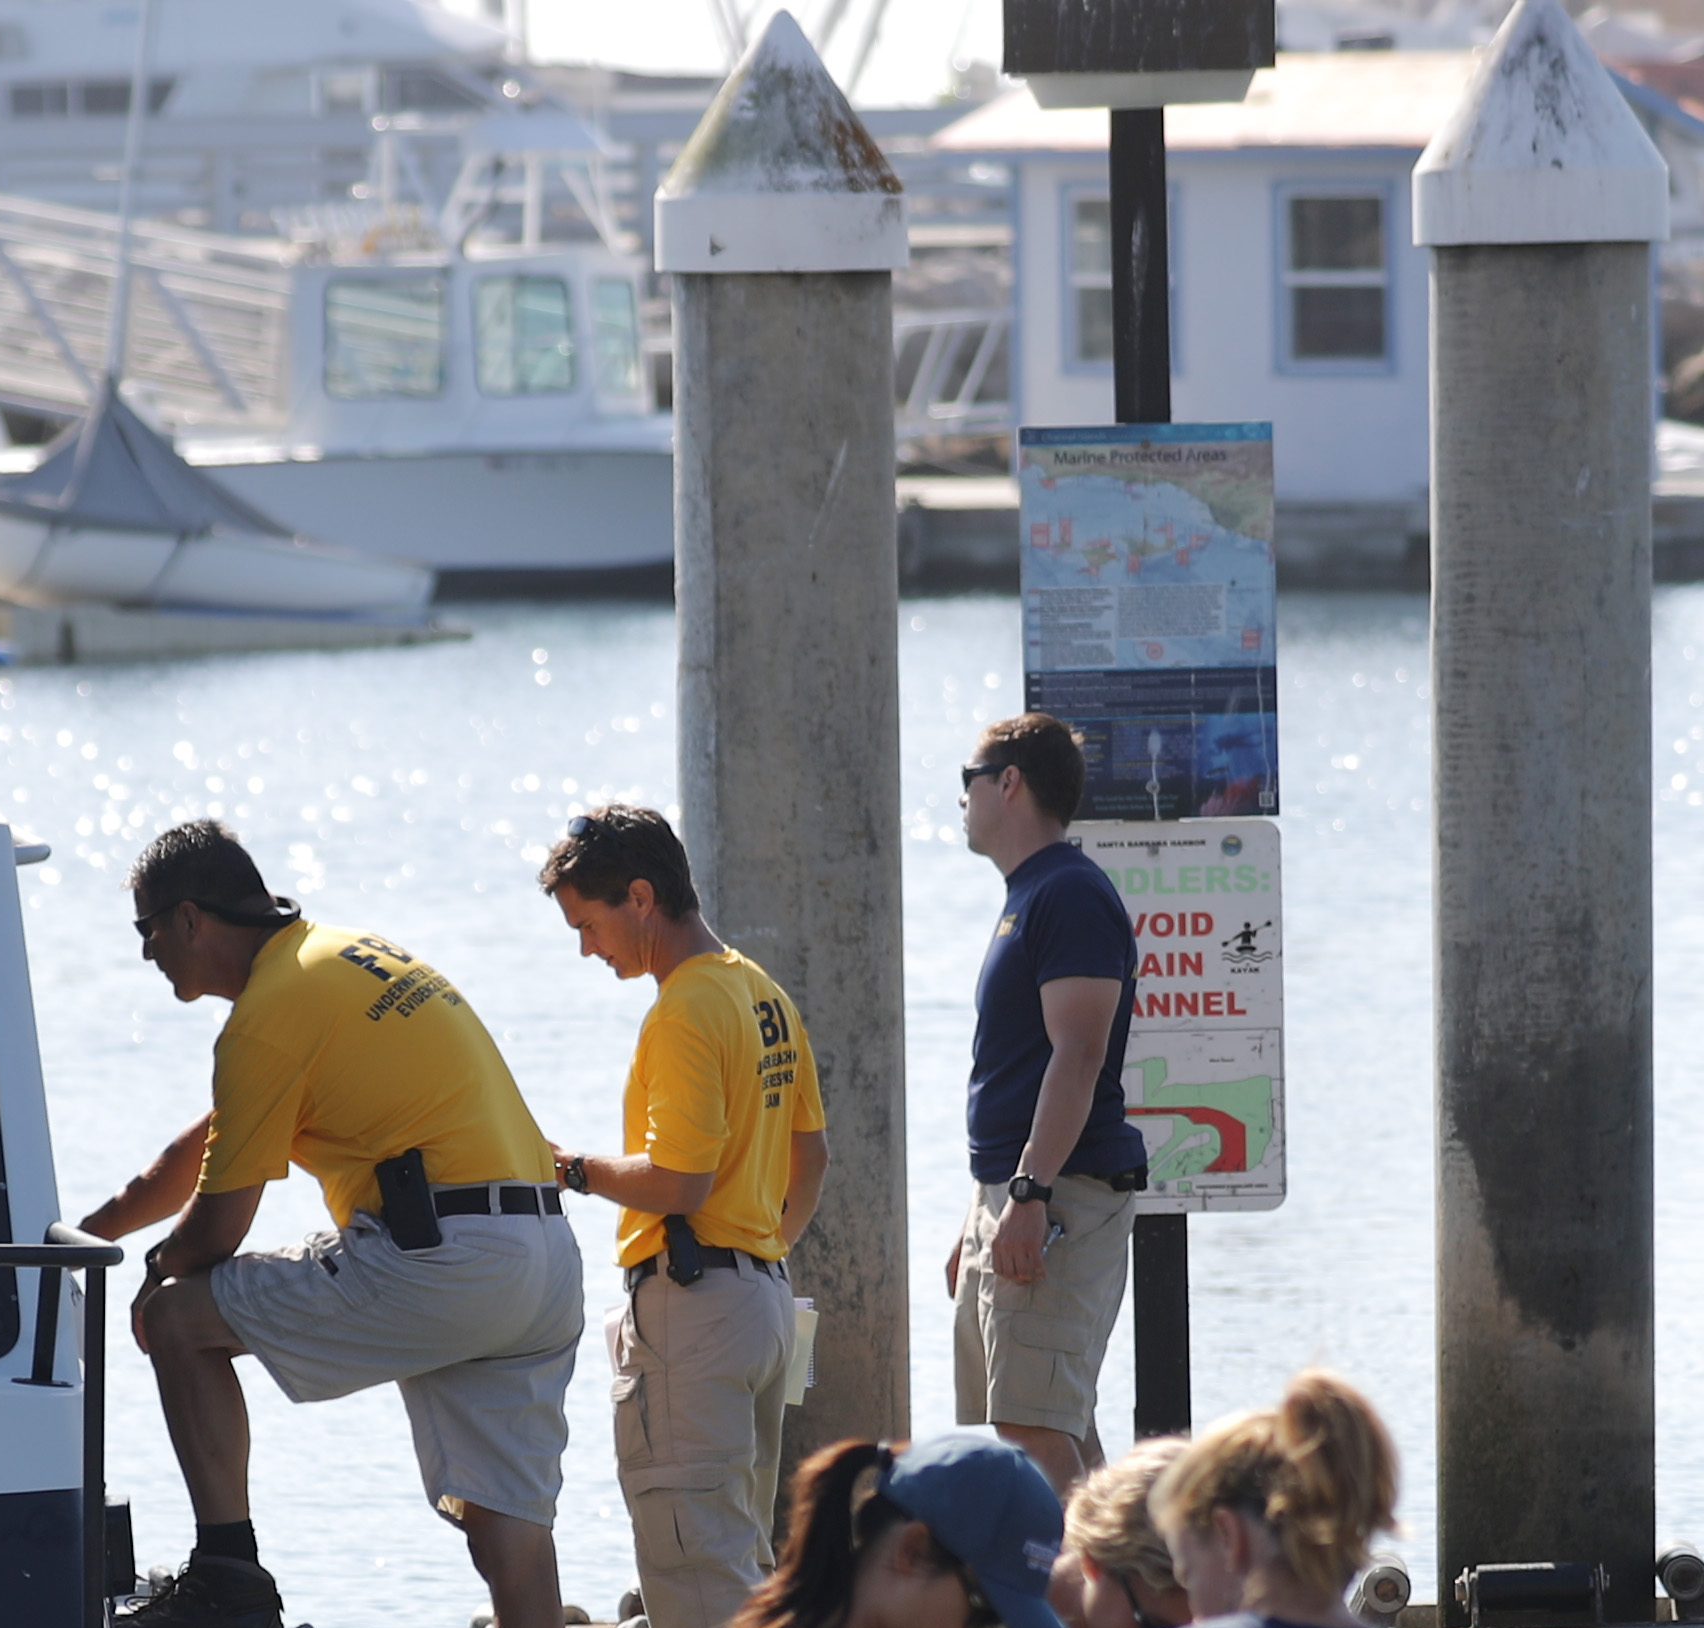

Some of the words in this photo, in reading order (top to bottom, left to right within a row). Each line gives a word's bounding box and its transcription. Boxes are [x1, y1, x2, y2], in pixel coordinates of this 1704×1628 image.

[1054, 450, 1106, 466] Marine
[1110, 449, 1182, 464] Protected
[1186, 448, 1227, 462] Areas
[1170, 838, 1206, 846] HARBOR
[1103, 864, 1271, 895] DLERS:
[1131, 911, 1214, 938] VOID
[339, 937, 413, 982] FB
[1138, 952, 1204, 978] AIN
[1131, 991, 1247, 1018] ANNEL
[753, 998, 789, 1048] BI
